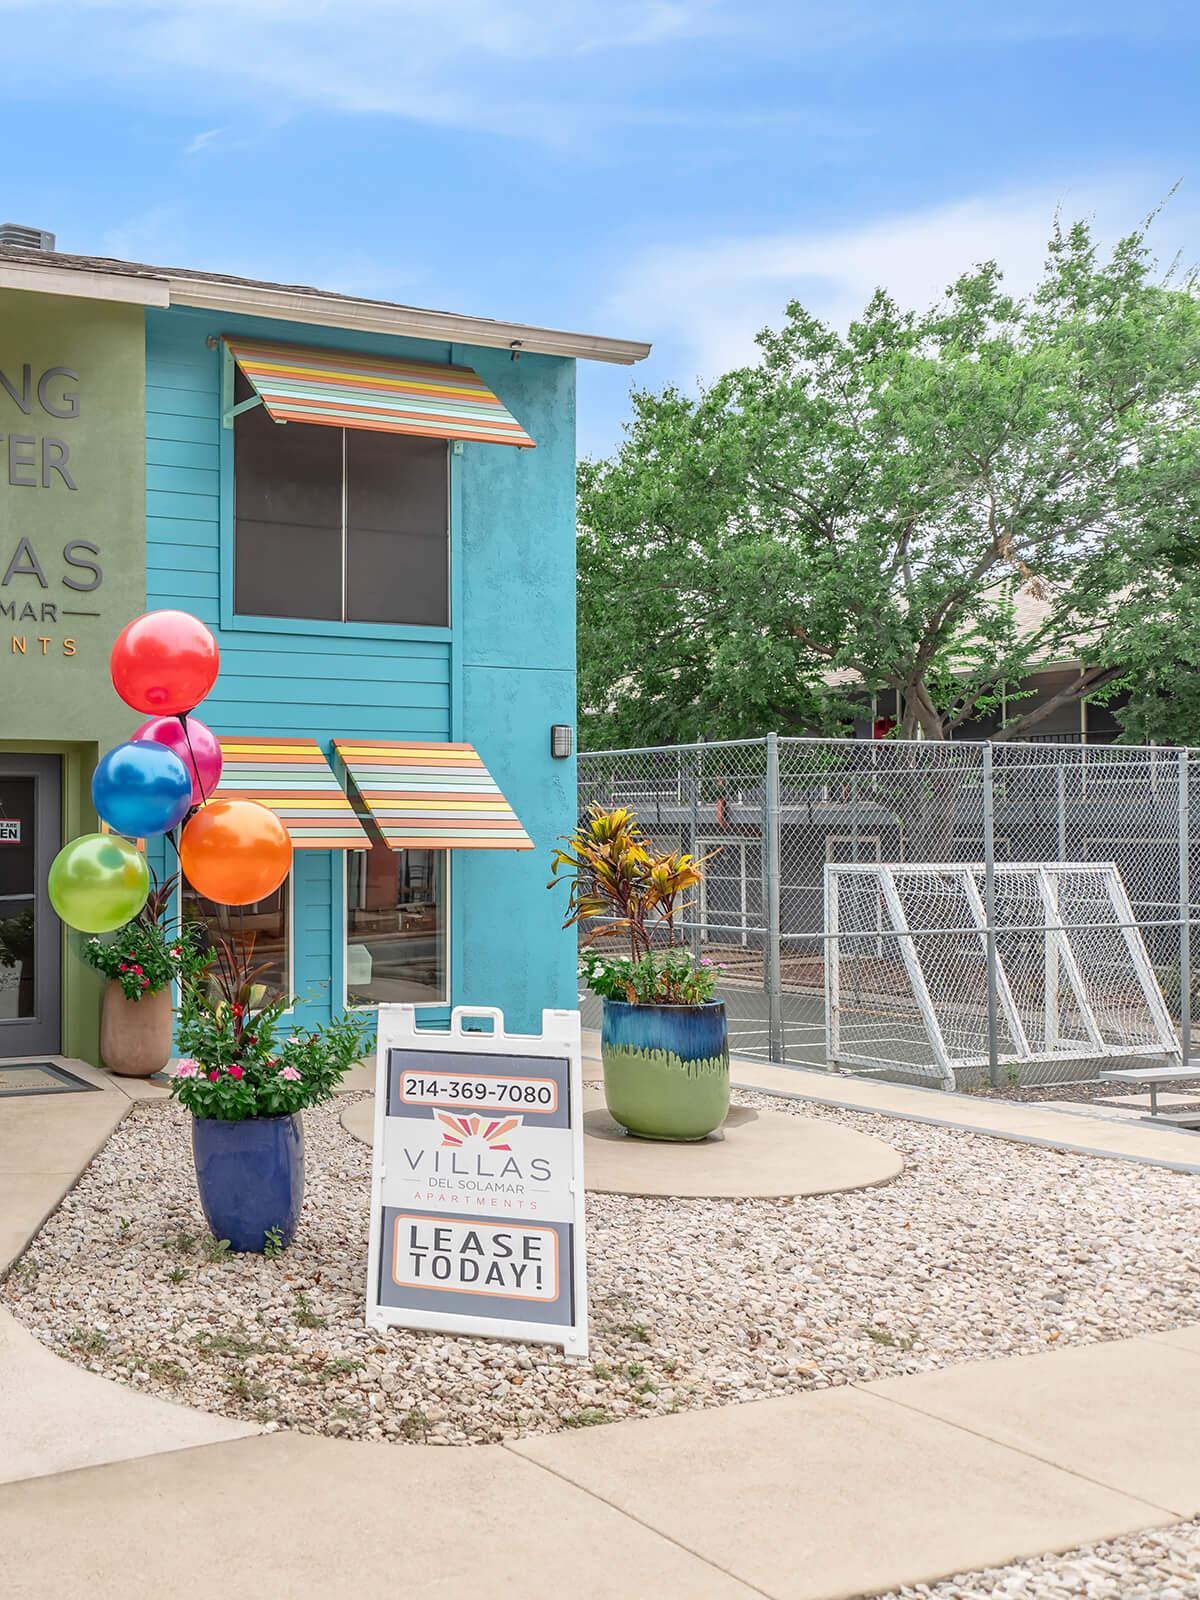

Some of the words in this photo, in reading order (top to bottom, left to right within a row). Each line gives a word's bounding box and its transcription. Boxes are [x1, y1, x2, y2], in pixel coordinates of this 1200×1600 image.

[405, 1079, 552, 1104] 214-369-7080
[404, 1148, 552, 1182] VILLAS
[414, 1191, 537, 1210] APARTMENTS
[429, 1177, 454, 1190] DEL
[458, 1179, 525, 1195] SOLAMAR
[409, 1225, 543, 1262] LEASE
[409, 1252, 544, 1290] TODAY!
